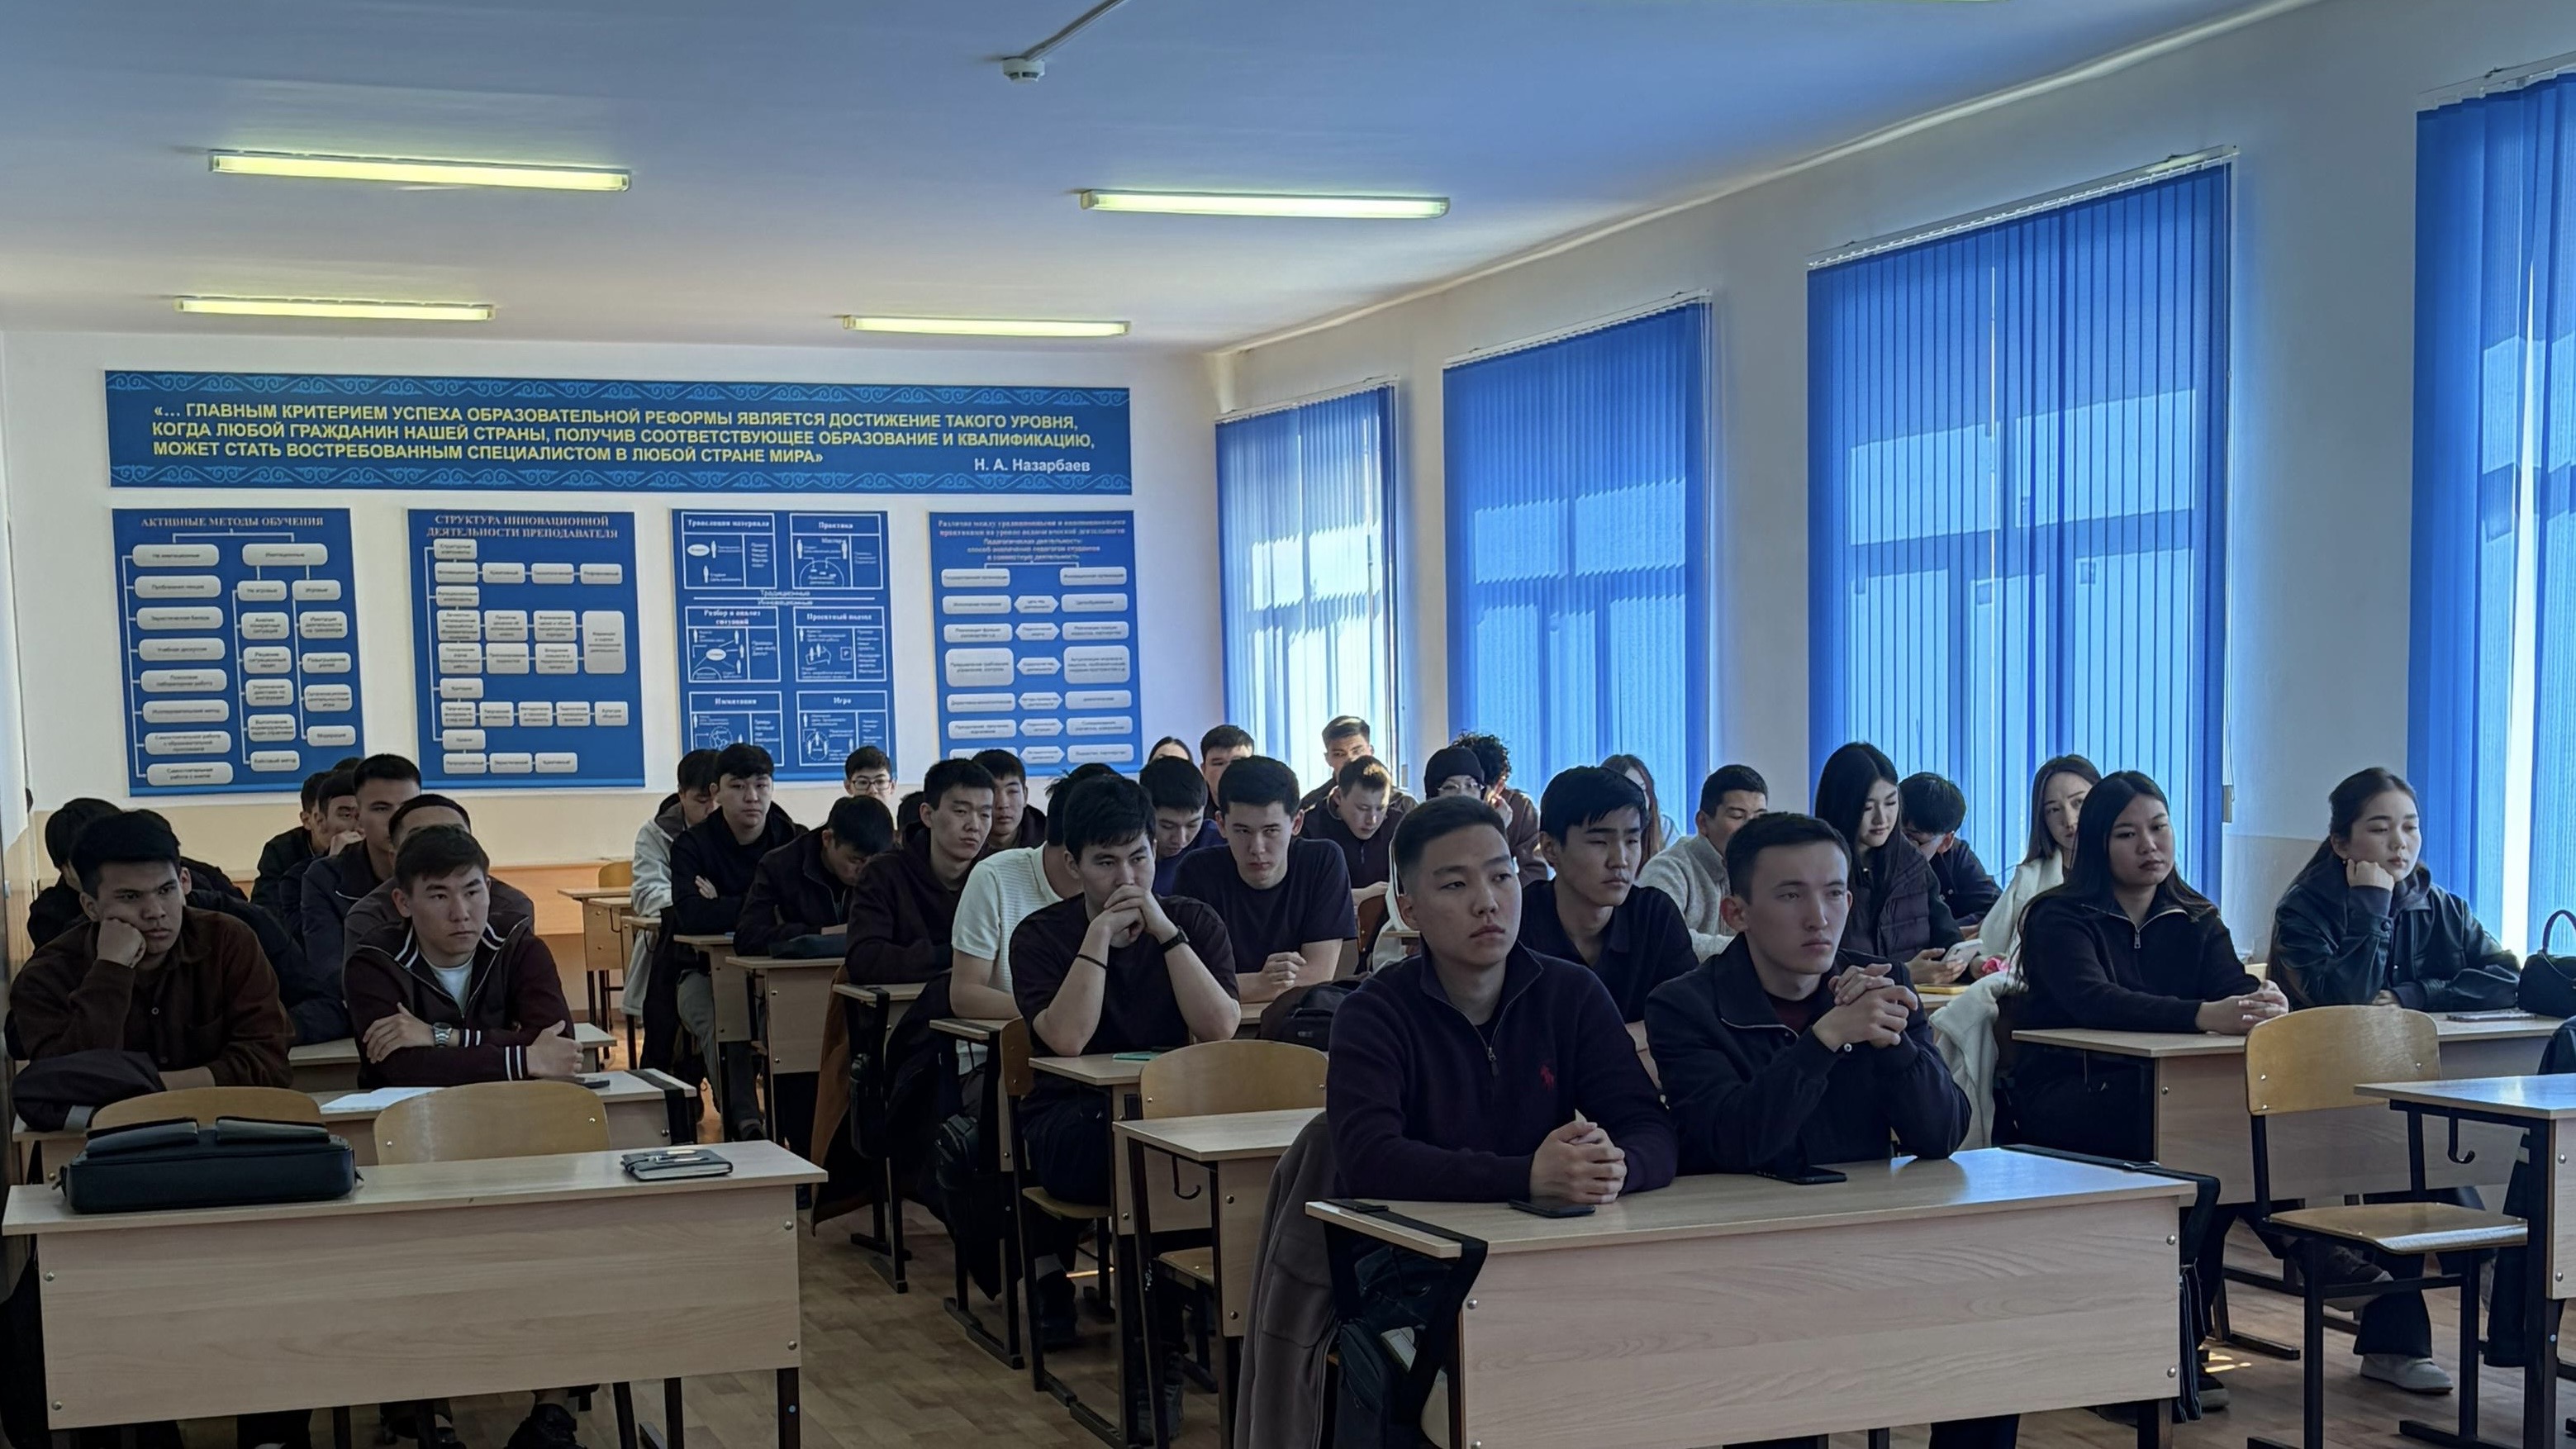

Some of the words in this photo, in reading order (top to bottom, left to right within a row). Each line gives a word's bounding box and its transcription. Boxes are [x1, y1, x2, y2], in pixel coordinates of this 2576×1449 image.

[186, 403, 277, 419] ГЛАВНЫМ
[283, 404, 387, 420] КРИТЕРИЕМ
[392, 406, 463, 421] УСПЕХА
[467, 407, 640, 425] ОБРАЗОВАТЕЛЬНОЙ
[645, 411, 733, 425] РЕФОРМЫ
[738, 411, 825, 427] ЯВЛЯЕТСЯ
[829, 413, 941, 430] ДОСТИЖЕНИЕ
[946, 414, 1006, 429] ТАКОГО
[1011, 415, 1079, 430] УРОВНЯ,
[152, 422, 211, 438] КОГДА
[216, 420, 285, 438] ЛЮБОЙ
[290, 424, 399, 440] ГРАЖДАНИН
[404, 424, 468, 441] НАШЕЙ
[473, 426, 551, 443] СТРАНЫ,
[555, 429, 636, 443] ПОЛУЧИВ
[640, 430, 814, 446] СООТВЕТСТВУЮЩЕЕ
[819, 432, 939, 447] ОБРАЗОВАНИЕ
[943, 433, 953, 447] И
[958, 434, 1096, 449] КВАЛИФИКАЦИЮ,
[154, 441, 220, 456] МОЖЕТ
[225, 442, 282, 457] СТАТЬ
[288, 443, 463, 459] ВОСТРЕБОВАННЫМ
[467, 445, 611, 463] СПЕЦИАЛИСТОМ
[615, 448, 627, 461] В
[632, 447, 696, 463] ЛЮБОЙ
[701, 449, 764, 463] СТРАНЕ
[770, 449, 824, 463] МИРА»
[974, 458, 990, 472] Н.
[993, 458, 1009, 472] А.
[1012, 458, 1091, 473] Назарбаев
[141, 517, 206, 527] АКТИВНЫЕ
[207, 516, 259, 527] МЕТОДЫ
[261, 515, 324, 527] ОБУЧЕНИЯ
[435, 515, 501, 526] СТРУКТУРА
[503, 515, 610, 527] ИННОВАЦИОННОЙ
[426, 527, 520, 538] ДЕЯТЕЛЬНОСТИ
[522, 528, 619, 539] ПРЕПОДАВАТЕЛЯ
